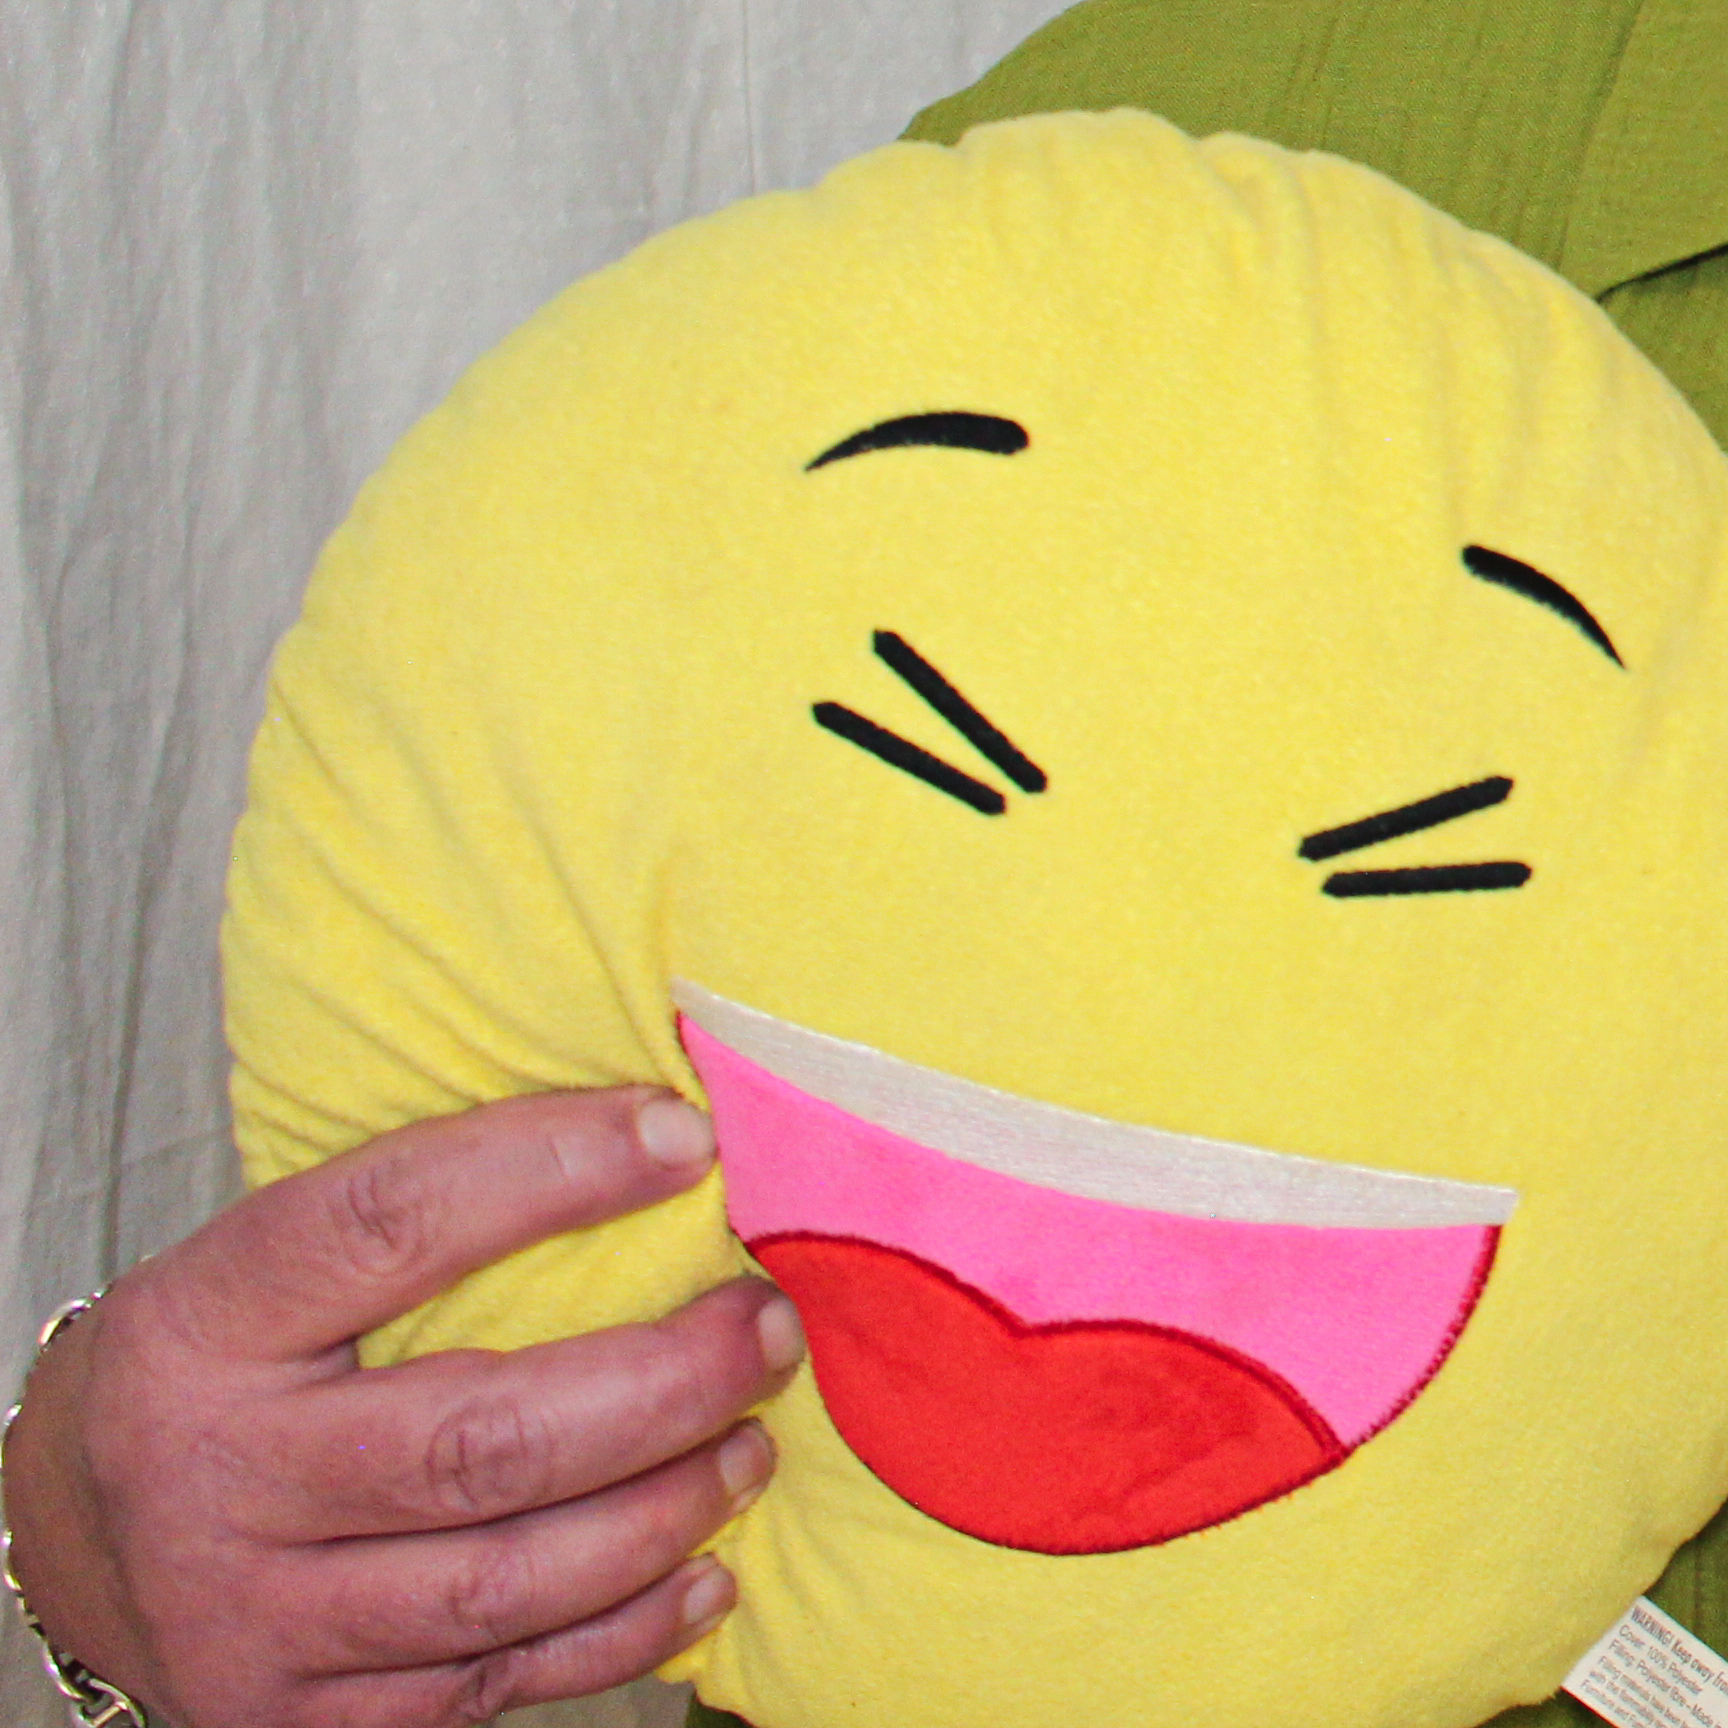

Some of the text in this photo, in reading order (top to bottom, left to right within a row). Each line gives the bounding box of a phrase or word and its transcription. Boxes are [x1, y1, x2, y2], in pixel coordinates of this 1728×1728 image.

[1631, 1606, 1673, 1645] WARNING!
[1670, 1638, 1692, 1664] Keep
[1690, 1658, 1714, 1682] away
[1646, 1645, 1668, 1669] 100%
[1667, 1661, 1703, 1695] Polyester
[1635, 1659, 1671, 1692] Polyester
[1690, 1703, 1713, 1728] Made
